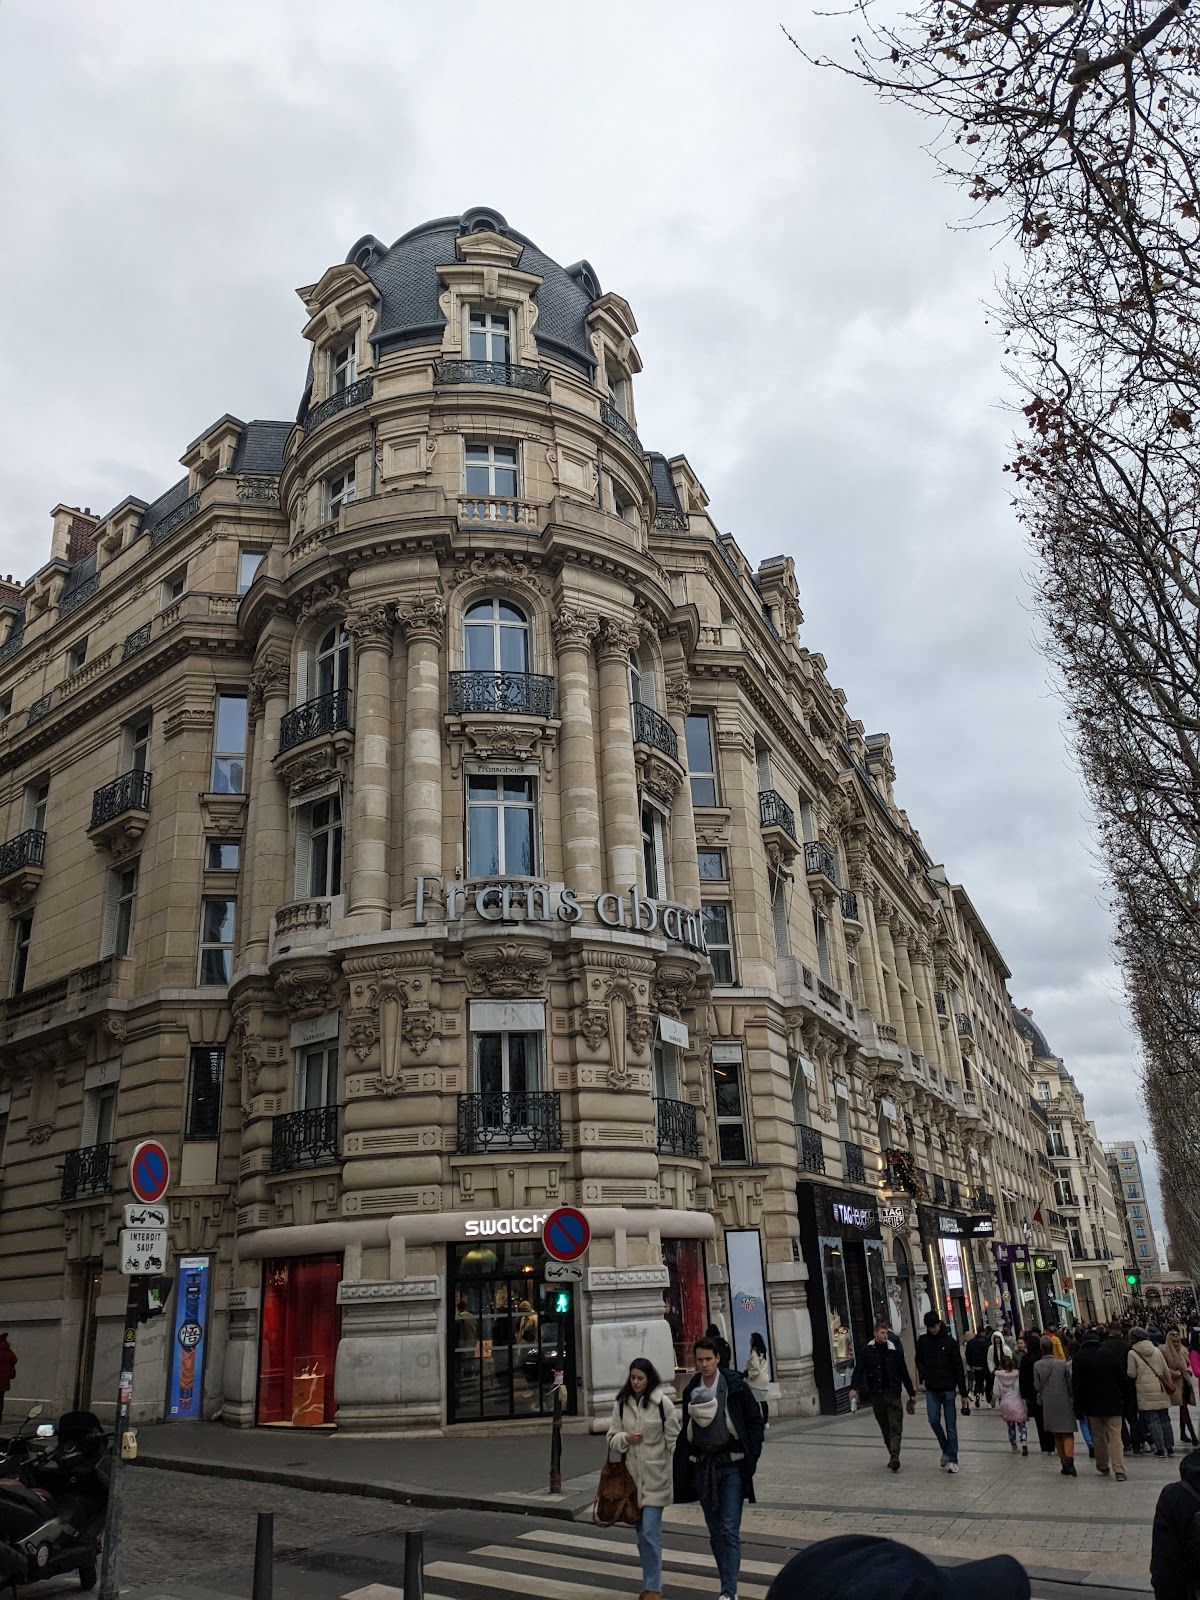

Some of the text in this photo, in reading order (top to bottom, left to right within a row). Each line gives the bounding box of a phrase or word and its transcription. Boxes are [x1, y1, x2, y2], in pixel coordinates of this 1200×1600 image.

[884, 1208, 901, 1216] TAG
[130, 1232, 161, 1241] INTERDIT
[136, 1243, 154, 1252] SAUF
